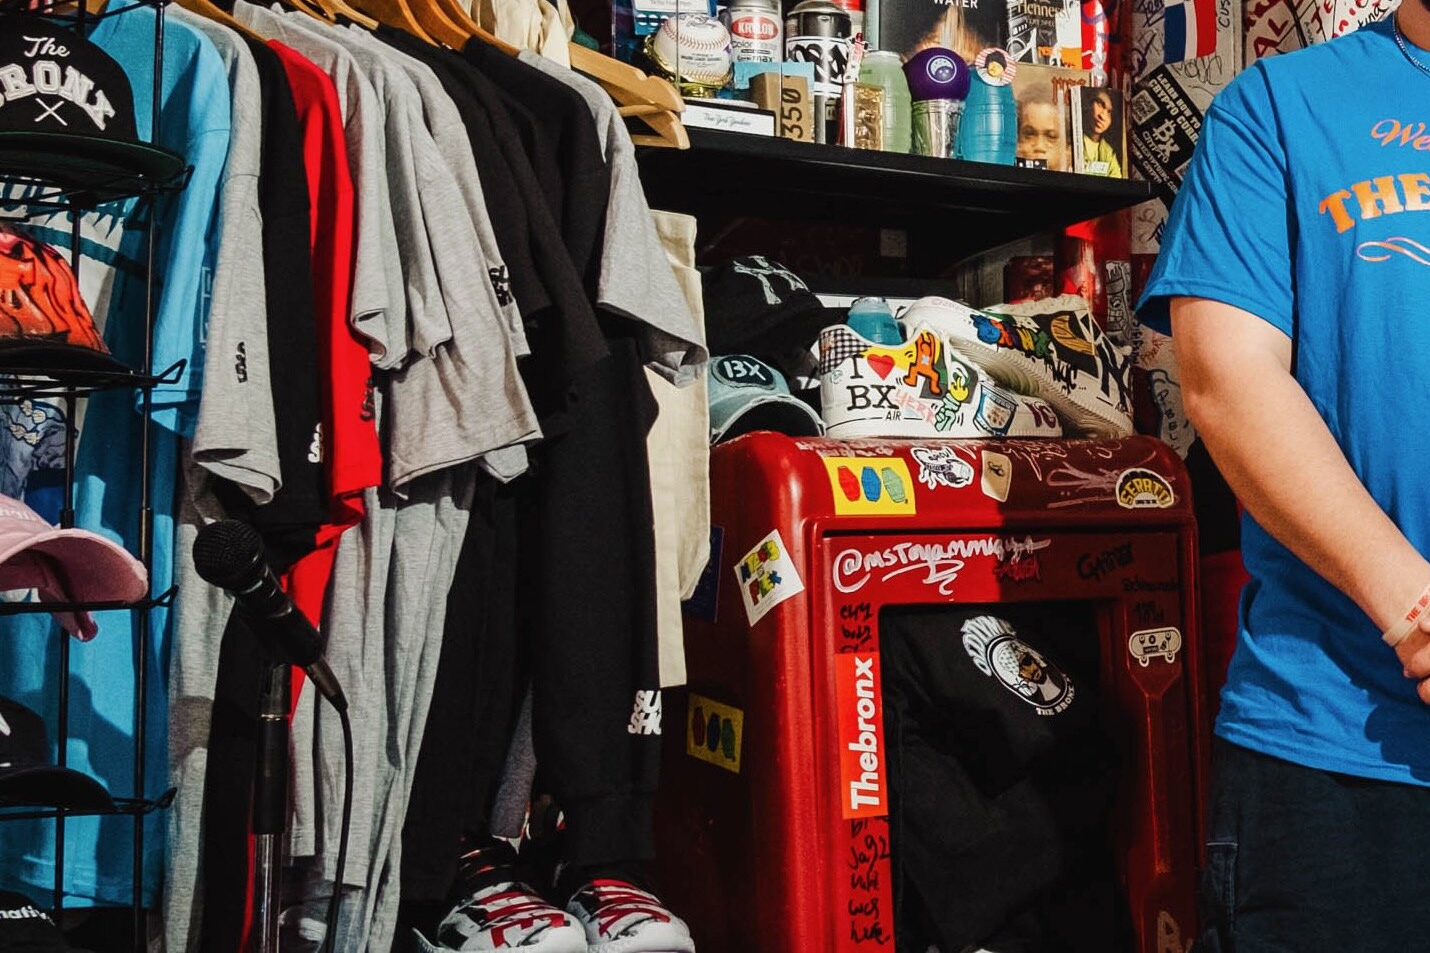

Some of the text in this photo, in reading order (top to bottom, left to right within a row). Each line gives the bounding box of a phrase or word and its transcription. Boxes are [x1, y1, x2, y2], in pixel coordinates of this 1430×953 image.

[23, 35, 70, 58] The
[1149, 79, 1178, 117] CRYPTO
[782, 88, 804, 139] 350
[722, 358, 769, 384] BX
[850, 355, 864, 379] I
[846, 385, 899, 412] BX
[884, 410, 902, 422] AIR
[1119, 477, 1173, 506] SERATO
[850, 656, 881, 812] Thebronx
